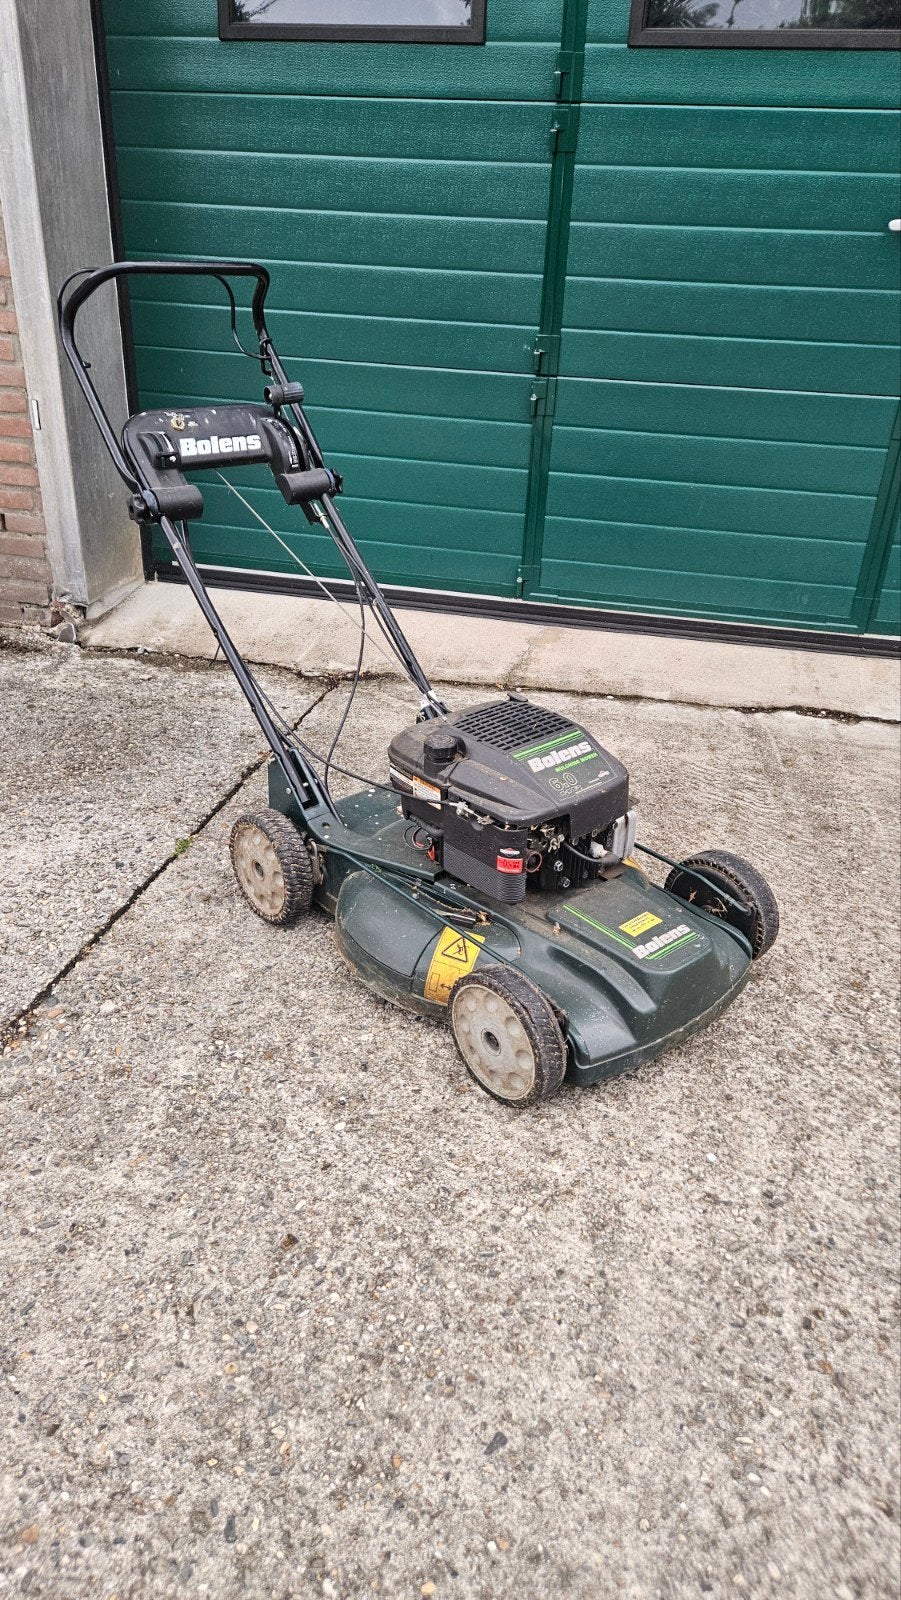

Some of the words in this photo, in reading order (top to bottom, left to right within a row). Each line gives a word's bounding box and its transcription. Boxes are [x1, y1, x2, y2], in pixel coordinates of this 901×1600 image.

[179, 434, 262, 457] Bolens
[527, 741, 592, 773] Bolens
[580, 752, 599, 763] MOWER
[549, 772, 578, 791] 6.0
[631, 923, 691, 960] Bolens
